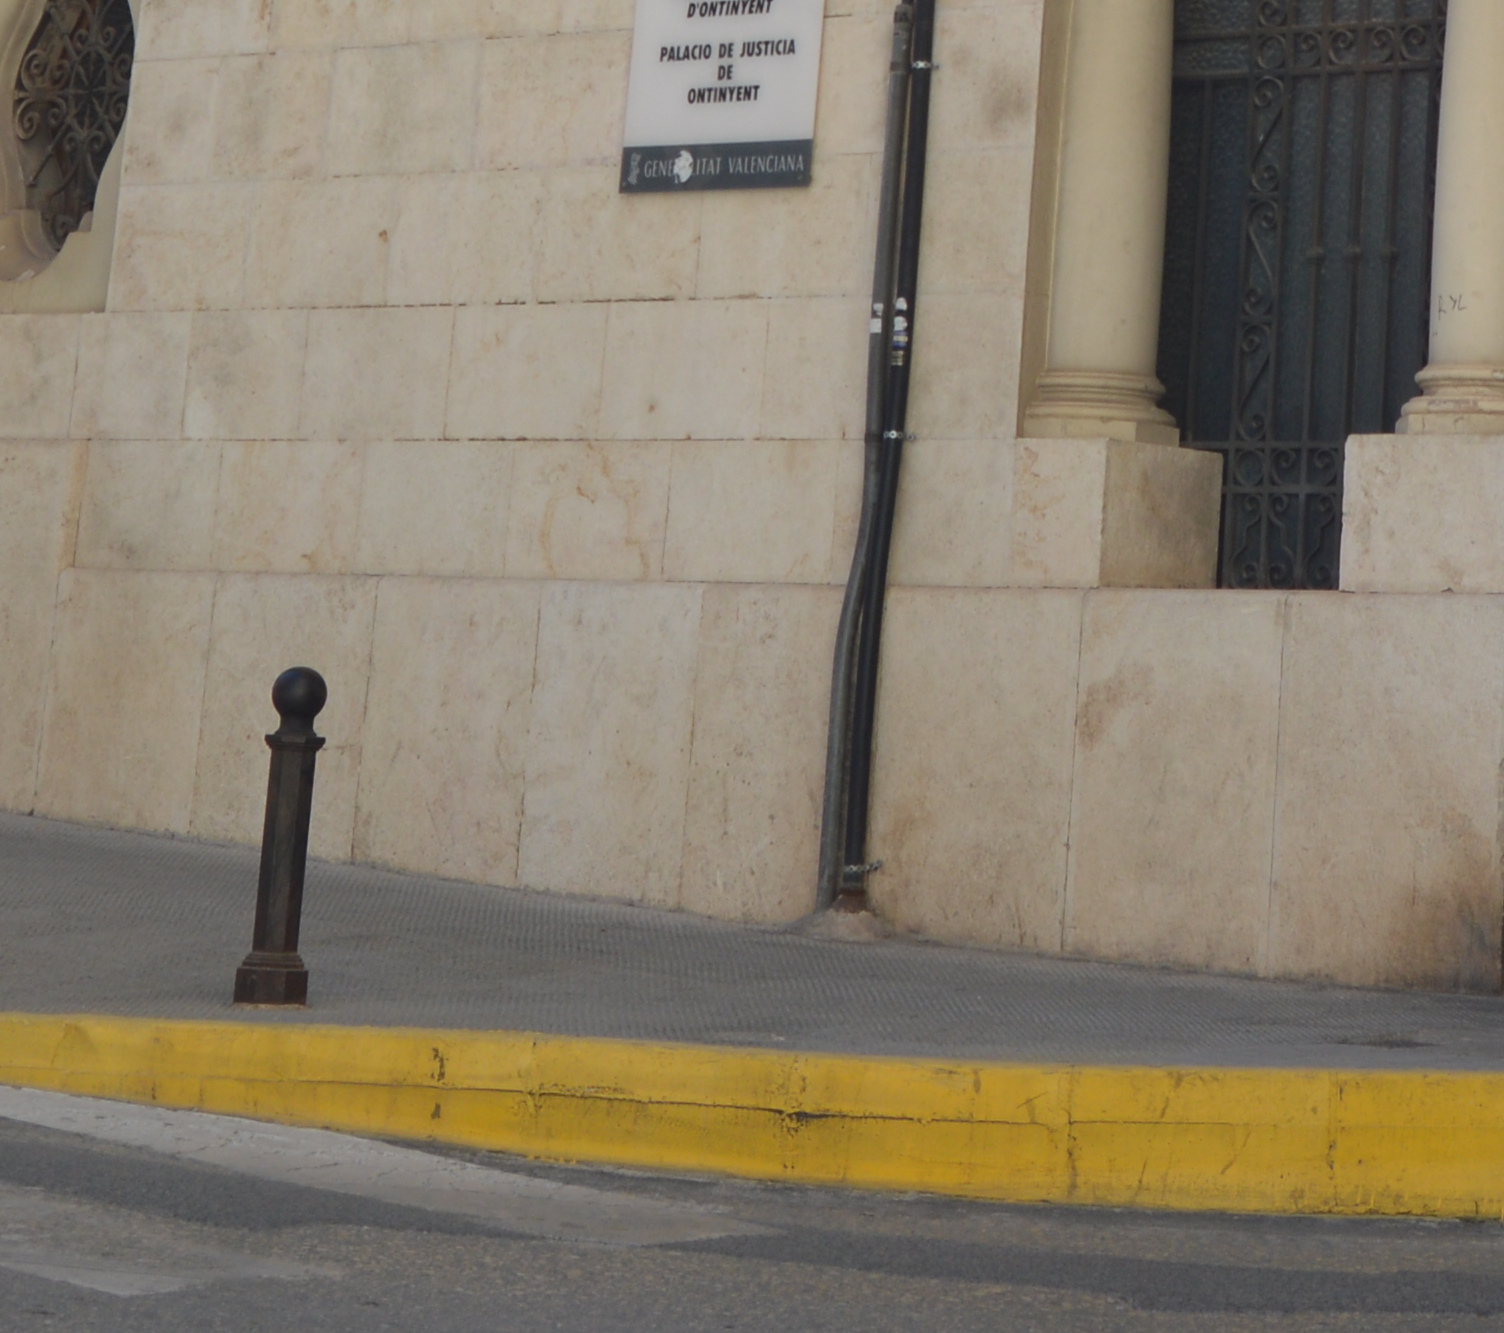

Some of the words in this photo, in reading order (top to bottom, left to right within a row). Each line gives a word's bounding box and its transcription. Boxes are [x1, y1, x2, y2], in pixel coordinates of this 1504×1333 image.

[659, 44, 712, 62] PALACIO
[718, 42, 734, 58] DE
[739, 39, 796, 58] JUSTICIA
[717, 64, 733, 80] DE
[687, 85, 760, 104] ONTINYENT
[644, 156, 721, 178] GENEITAT
[728, 154, 804, 174] VALENCIANA
